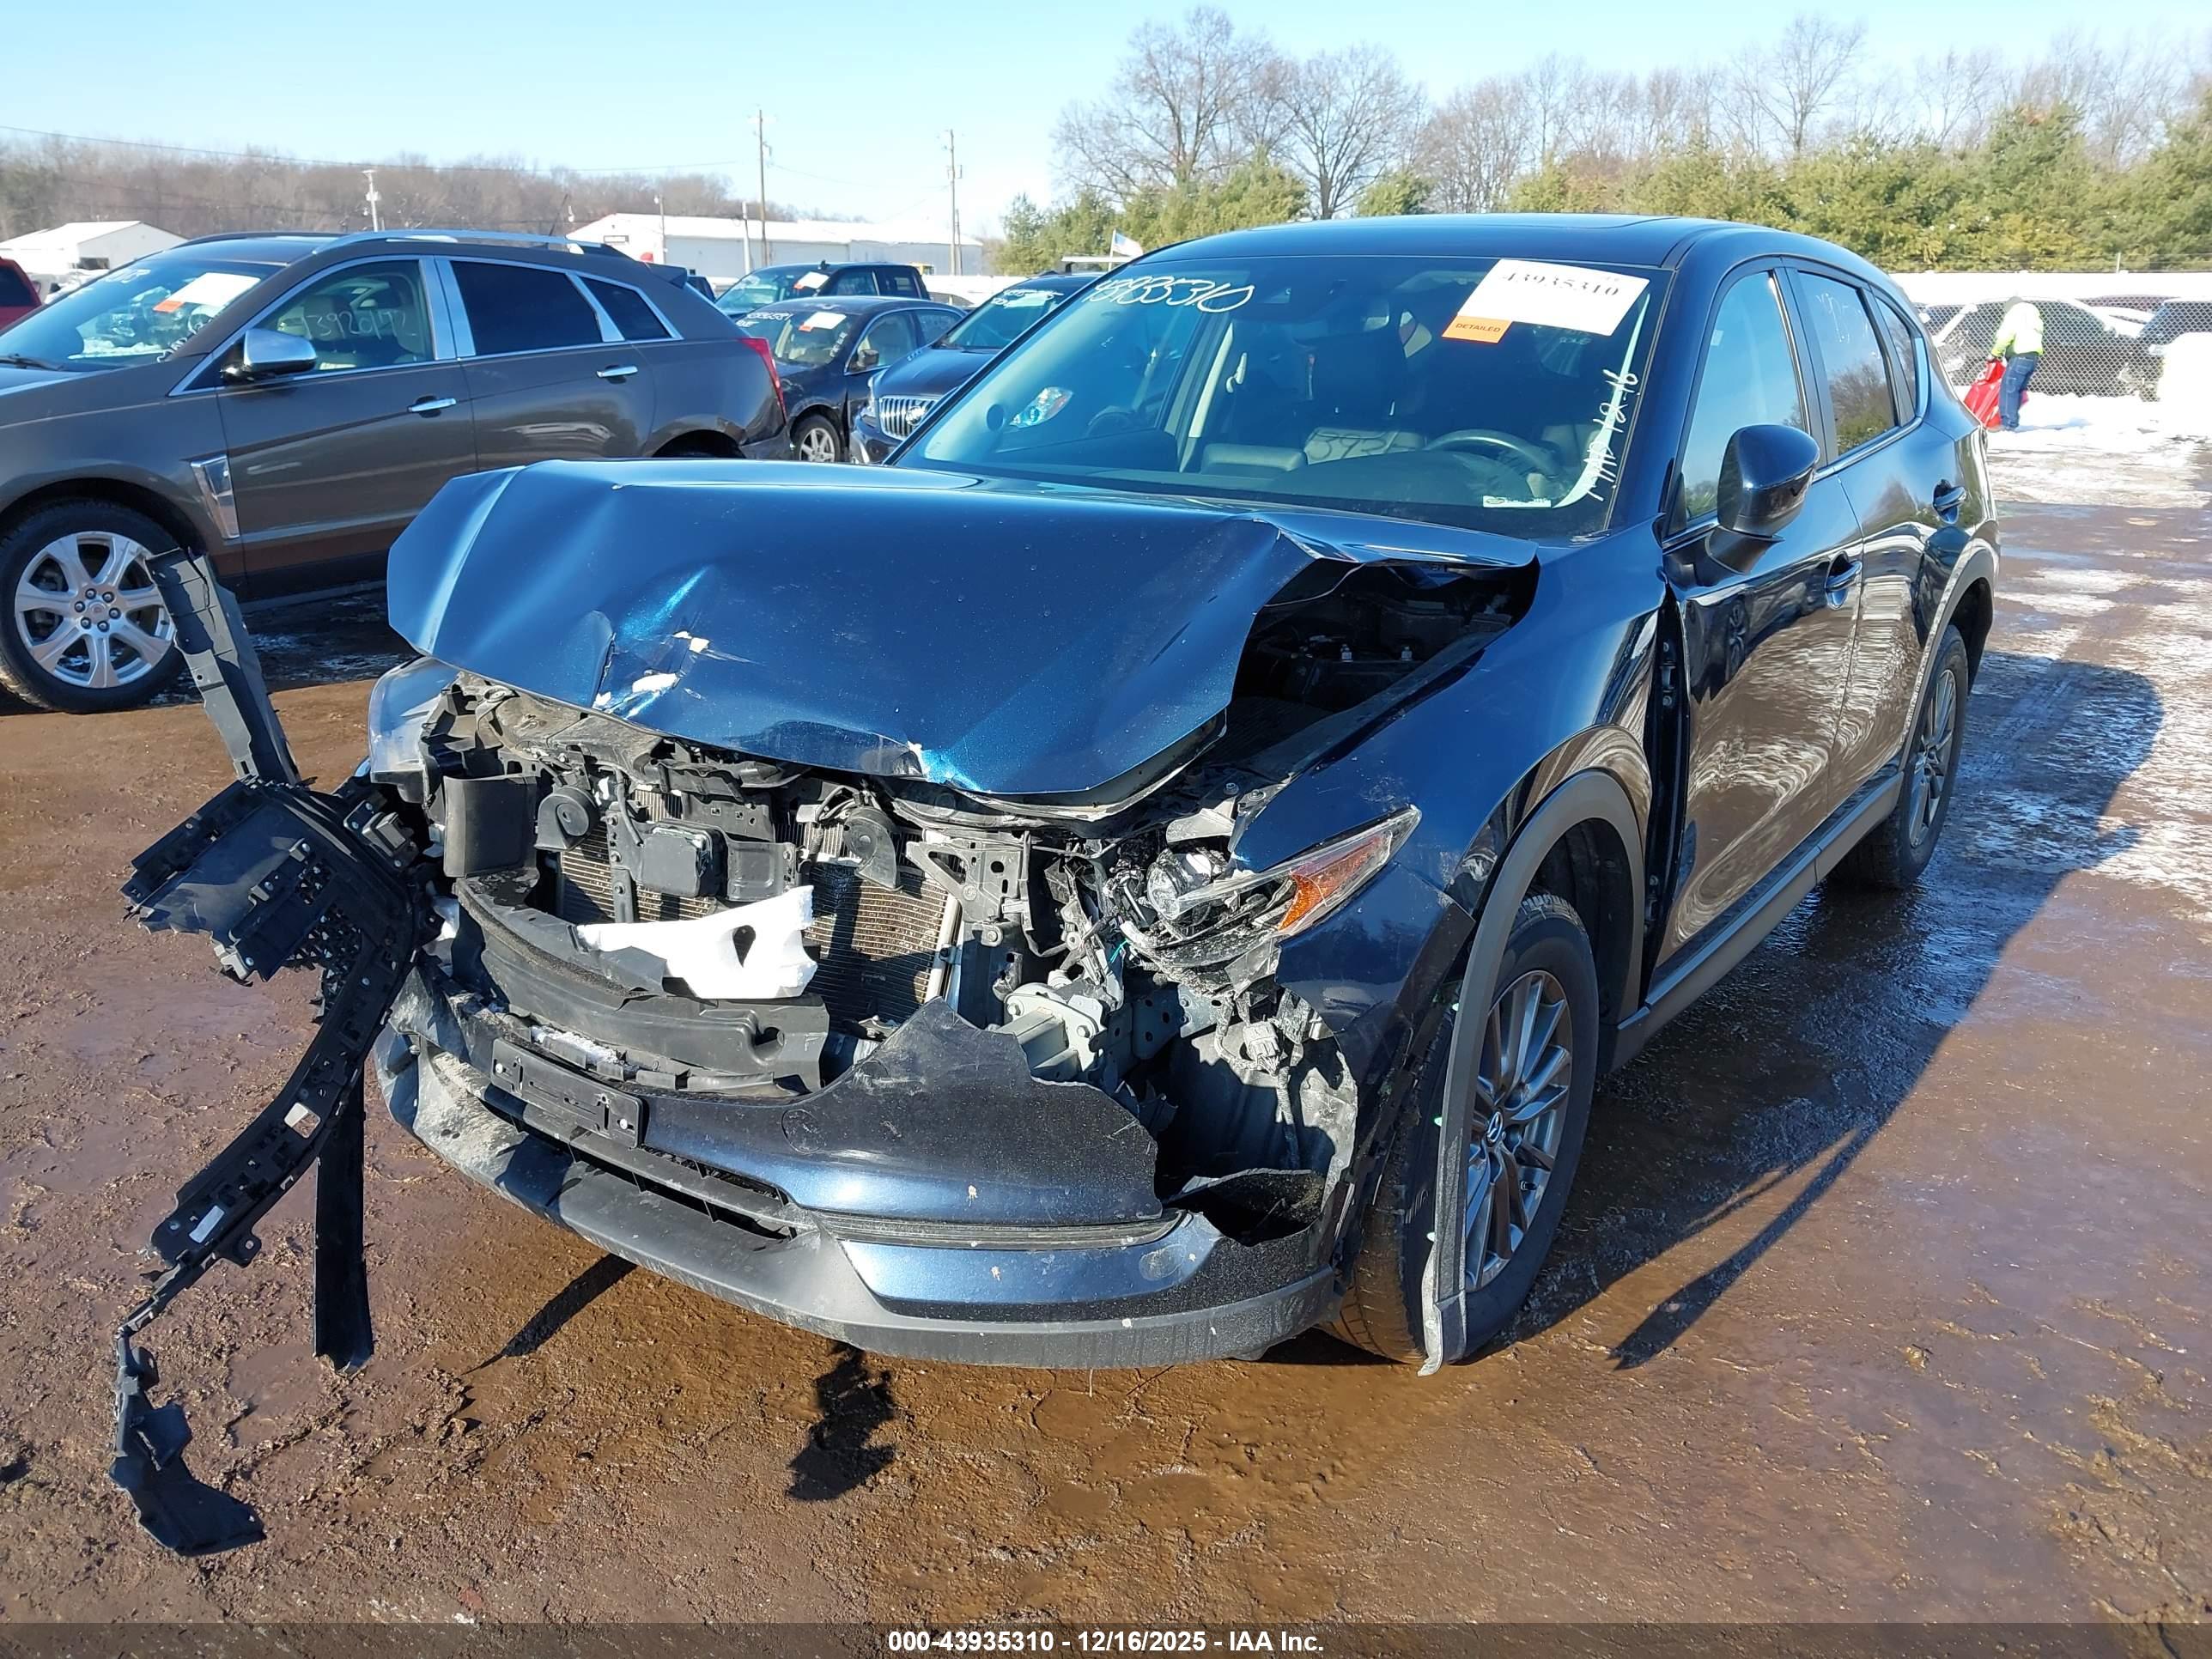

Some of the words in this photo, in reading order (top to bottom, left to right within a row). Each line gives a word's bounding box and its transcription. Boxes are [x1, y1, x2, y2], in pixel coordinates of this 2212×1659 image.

[1081, 276, 1255, 313] 43935310
[1503, 272, 1620, 296] 43935310
[1455, 322, 1501, 333] DETAILED
